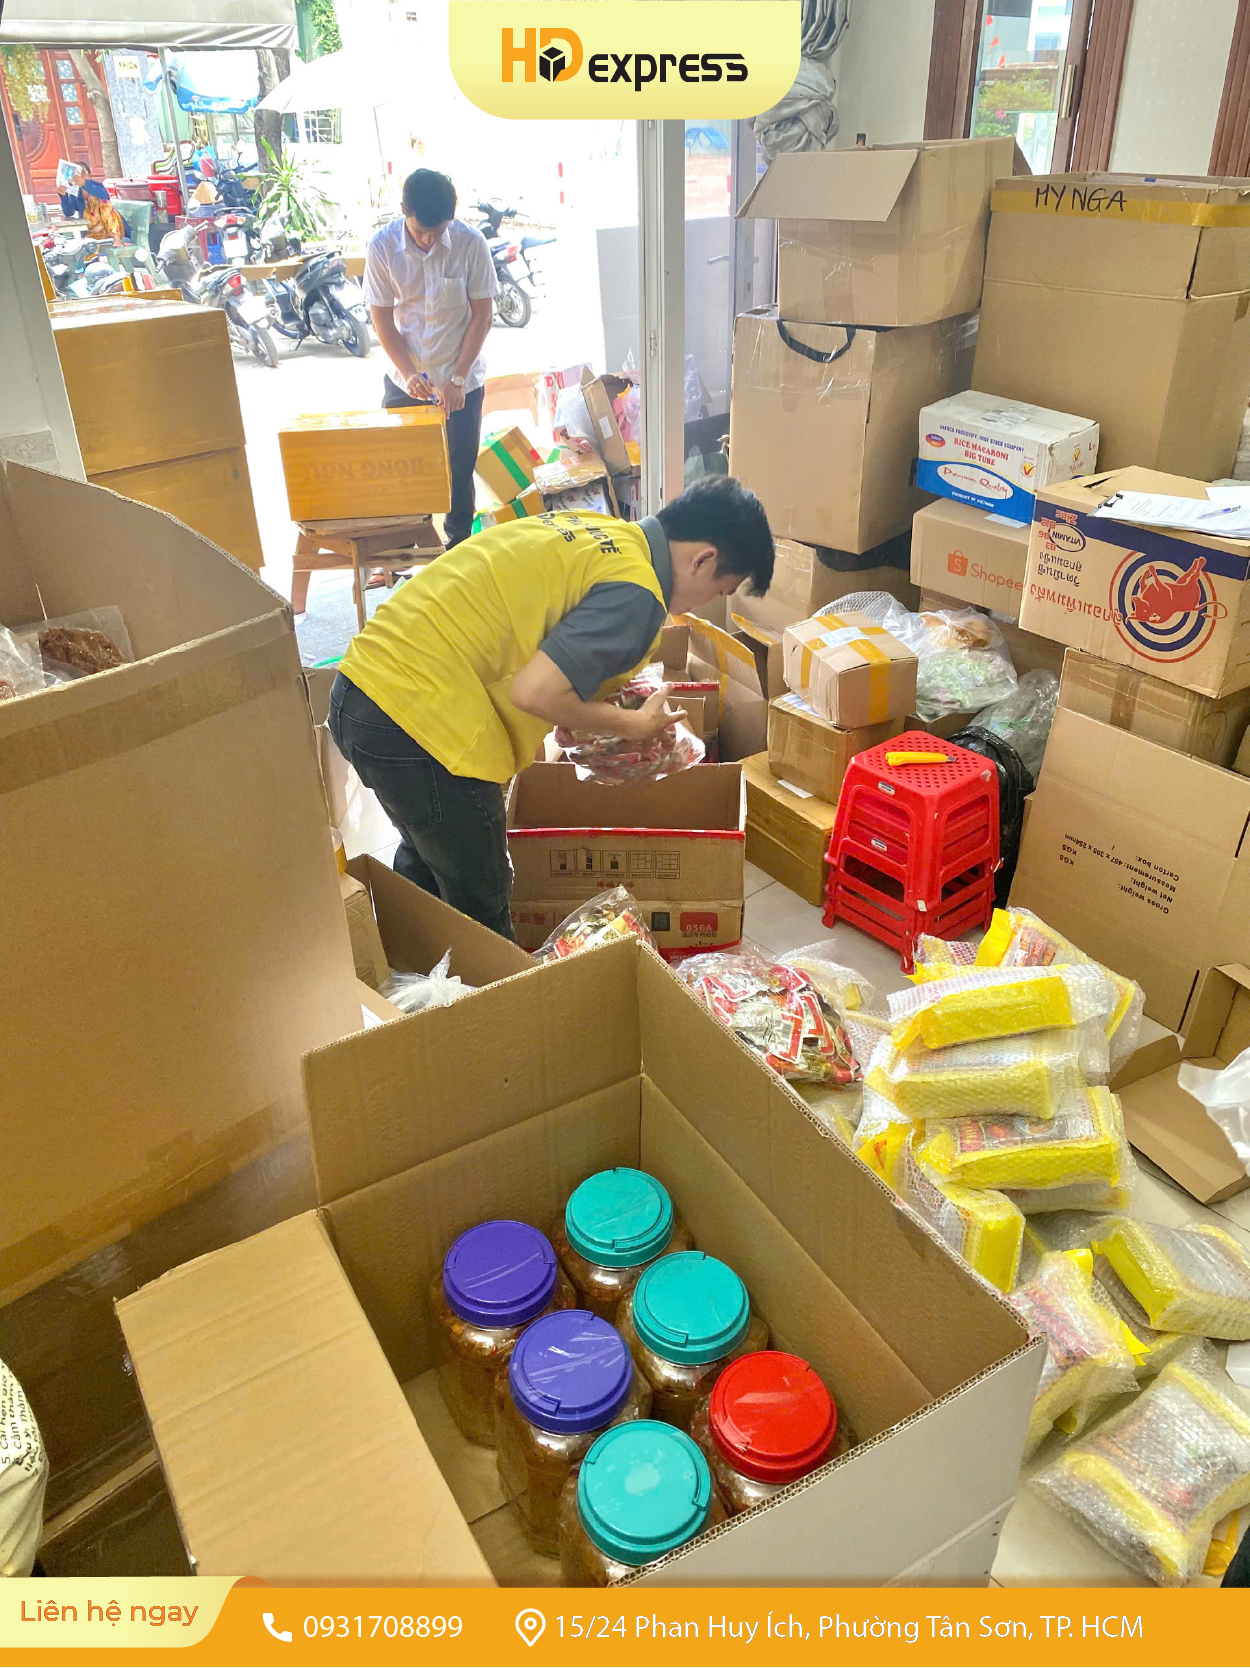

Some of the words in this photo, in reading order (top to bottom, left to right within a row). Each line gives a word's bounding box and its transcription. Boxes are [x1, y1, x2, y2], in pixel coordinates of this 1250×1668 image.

[1072, 186, 1127, 212] NGA
[953, 437, 971, 449] RICE
[971, 442, 1009, 461] MACARONI
[990, 437, 1003, 447] STOCK
[1004, 441, 1024, 453] COMPANY
[964, 451, 976, 461] BIG
[978, 455, 996, 466] TUBE
[978, 476, 1008, 500] Quality
[1041, 517, 1057, 529] B12
[1055, 509, 1078, 526] Zinc
[1038, 530, 1050, 540] B6
[1052, 530, 1081, 546] VITAMIN
[1045, 542, 1056, 551] B3
[971, 563, 1023, 591] Shopee
[1064, 833, 1087, 849] 254mm
[1061, 844, 1077, 856] KGS
[1059, 854, 1074, 866] KGS
[1110, 857, 1123, 866] 457
[1135, 855, 1152, 868] box:
[1123, 863, 1176, 893] Measurement:
[1154, 864, 1179, 882] Carton
[1117, 883, 1145, 901] weight:
[1130, 877, 1158, 895] weight:
[1147, 898, 1169, 914] Gross
[1160, 892, 1173, 904] Net
[686, 924, 712, 932] 056A
